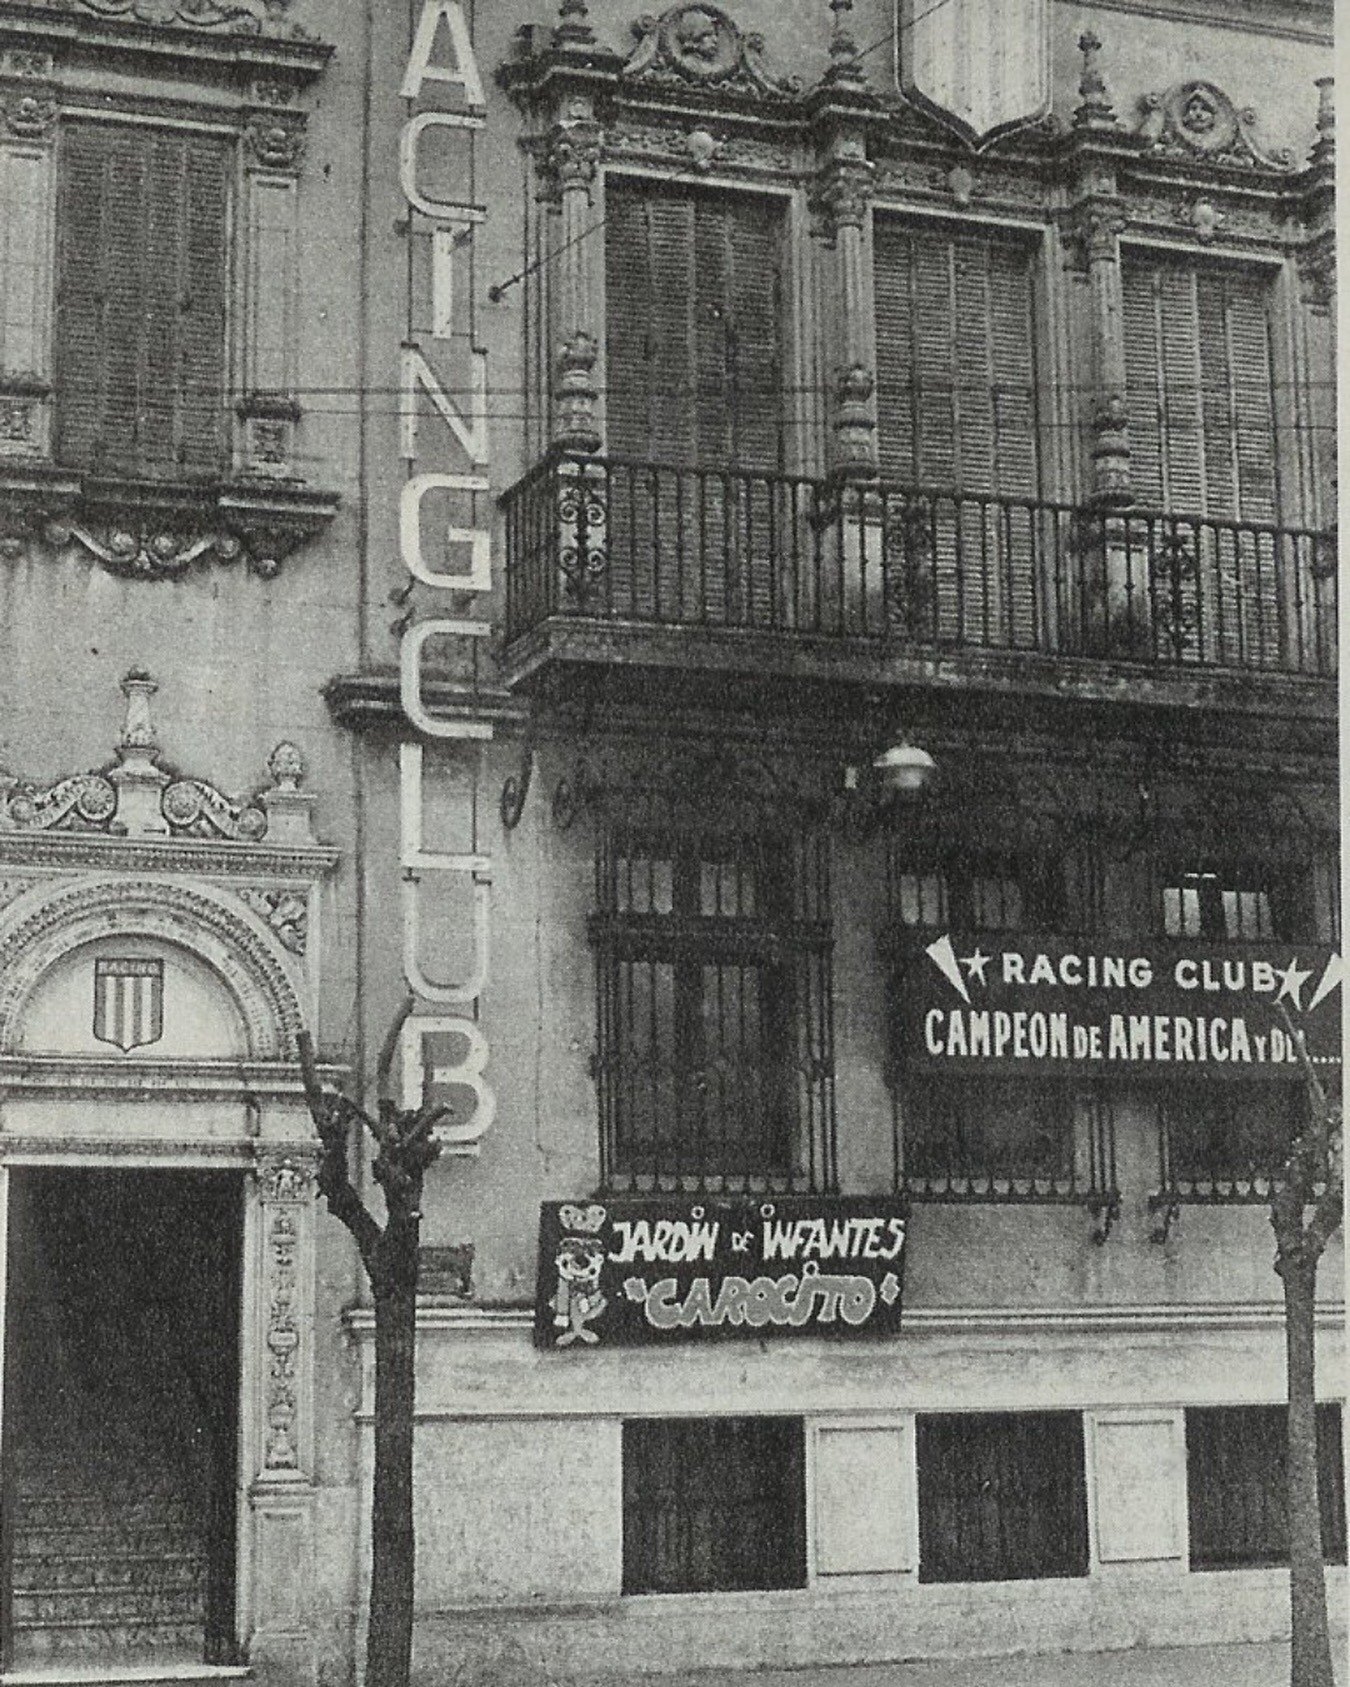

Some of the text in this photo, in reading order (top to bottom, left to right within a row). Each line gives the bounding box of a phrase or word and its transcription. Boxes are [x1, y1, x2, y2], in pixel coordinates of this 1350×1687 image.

[400, 620, 495, 1145] CLUB
[1001, 952, 1278, 993] RACING CLUB
[925, 1008, 1068, 1058] CAMPEON
[1072, 1025, 1102, 1060] DE
[1108, 1014, 1252, 1064] AMERICA
[1253, 1034, 1267, 1063] Y
[731, 1230, 755, 1252] DE
[760, 1203, 905, 1261] INFANTES
